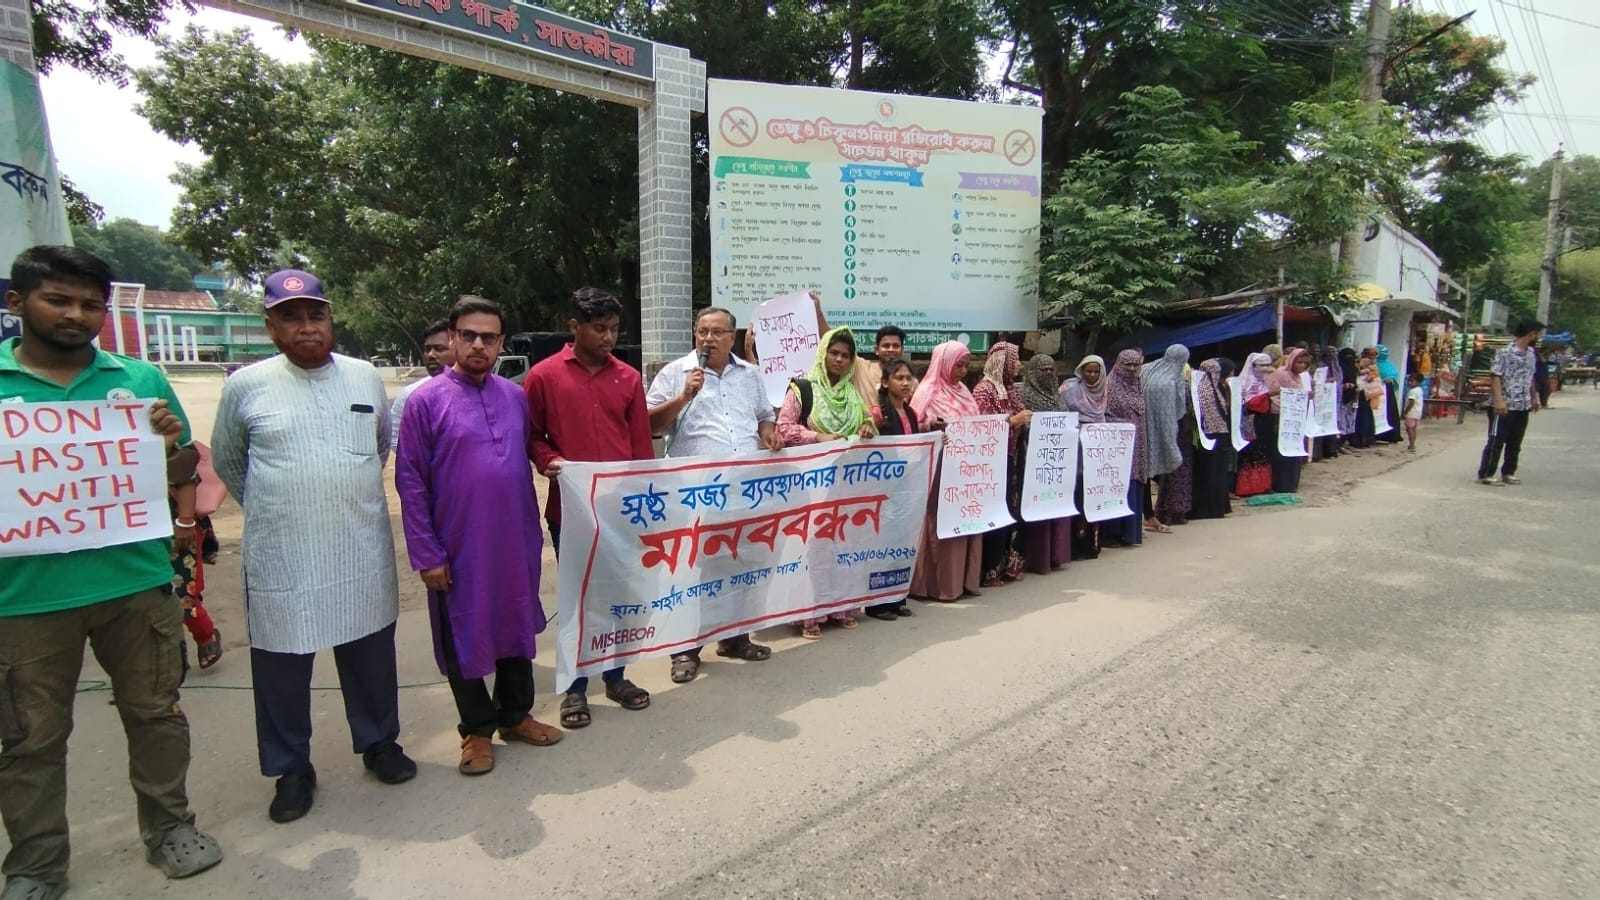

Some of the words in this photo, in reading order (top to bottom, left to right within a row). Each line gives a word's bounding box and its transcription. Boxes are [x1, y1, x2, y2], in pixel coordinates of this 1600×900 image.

[535, 18, 635, 67] সাতক্ষীরা
[842, 144, 885, 160] সচেতন
[889, 146, 928, 165] থাকুন
[3, 403, 145, 439] DON'T
[0, 438, 139, 474] HASTE
[18, 474, 135, 507] WITH
[620, 483, 669, 528] সুষ্ঠু
[678, 473, 730, 512] বর্জ্য
[741, 465, 838, 510] ব্যবস্থাপনার
[842, 451, 908, 485] দাবিতে
[944, 483, 999, 503] বাংলাদেশ
[0, 500, 149, 543] WASTE
[639, 495, 890, 575] মানববন্ধন
[591, 626, 656, 654] MISEREOR
